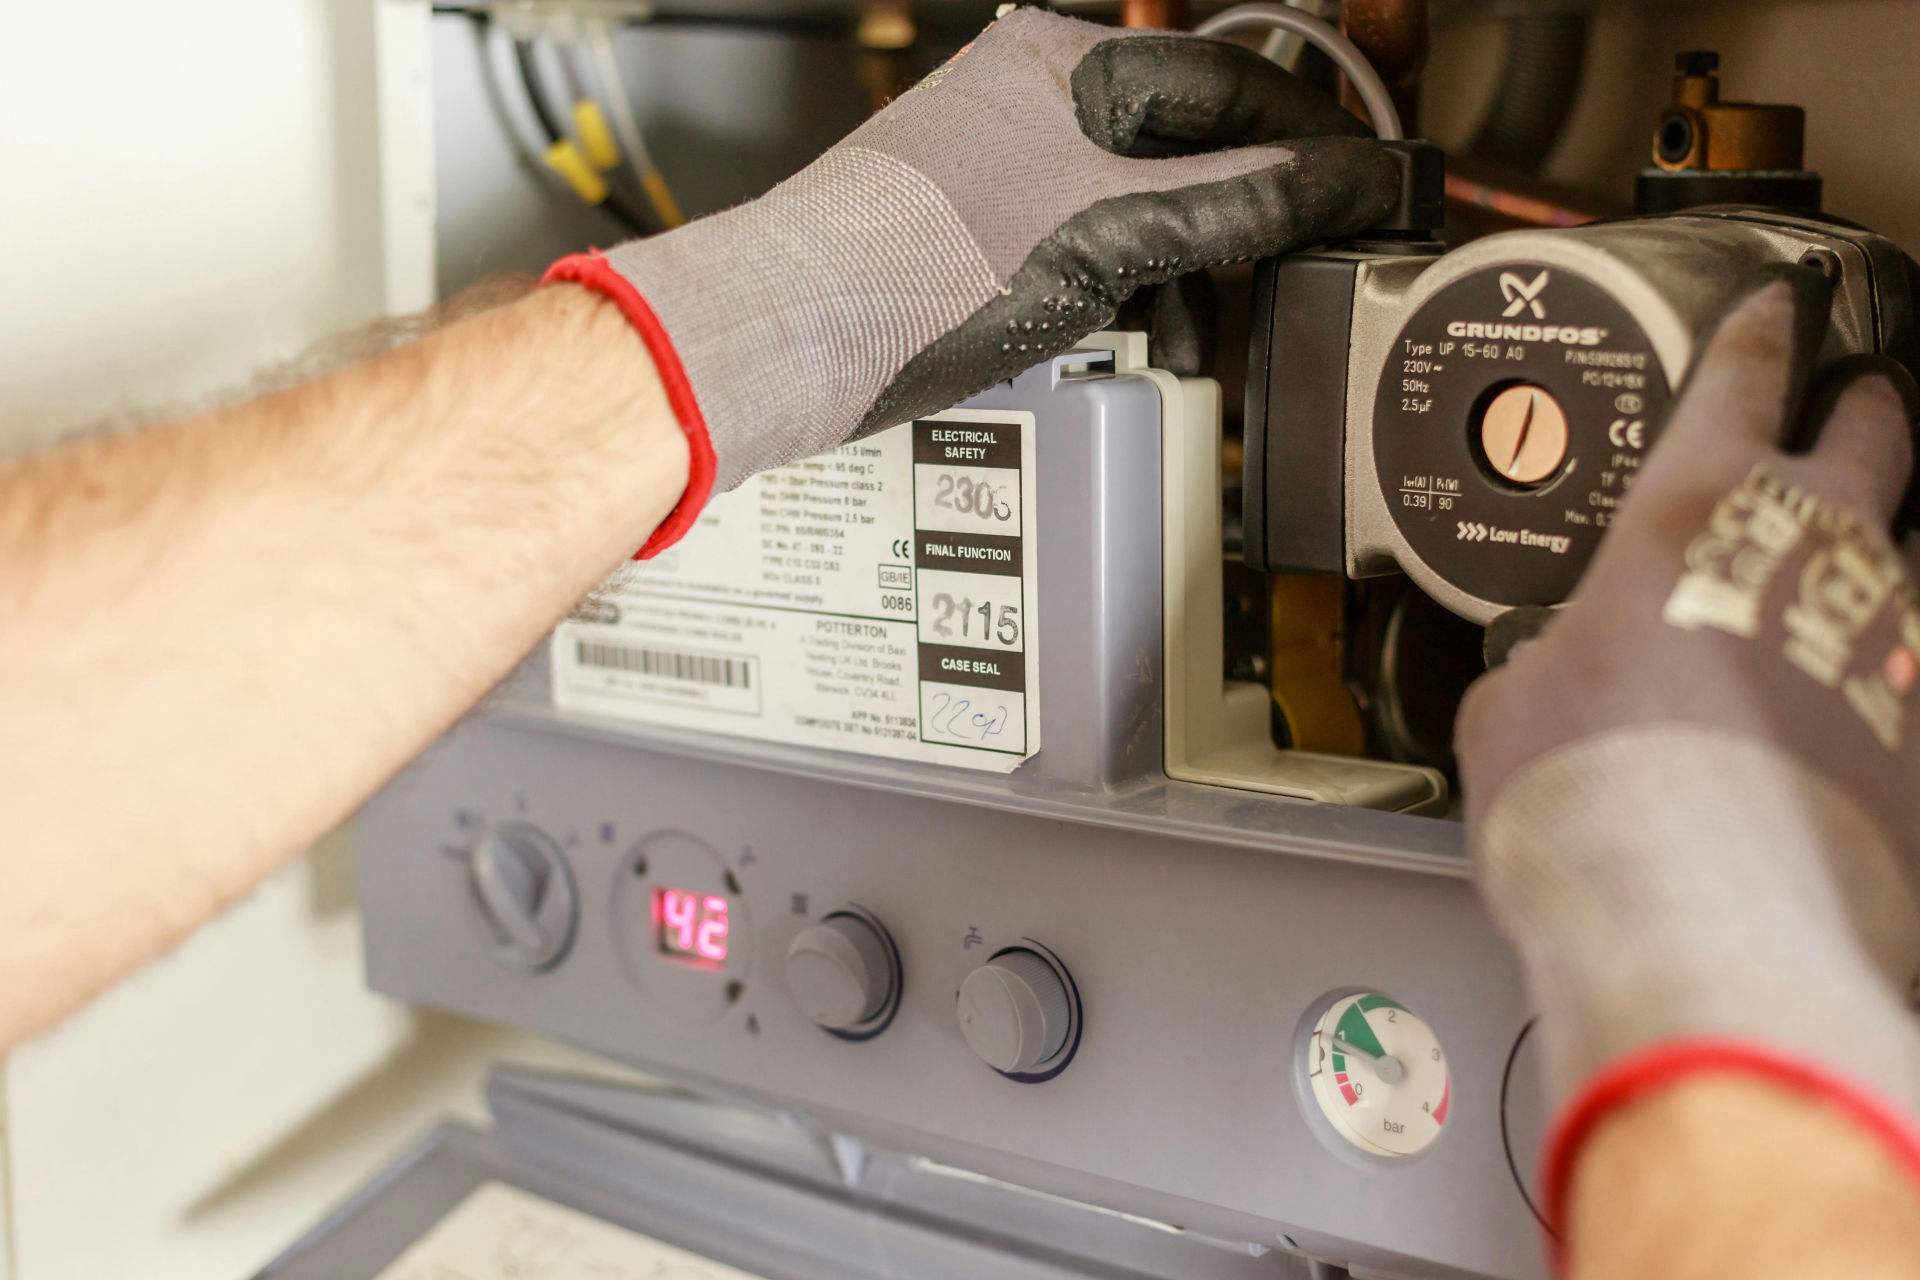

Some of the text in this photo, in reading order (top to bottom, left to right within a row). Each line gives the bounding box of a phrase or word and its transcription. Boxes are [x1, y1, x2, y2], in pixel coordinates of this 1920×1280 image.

[1447, 321, 1601, 346] GRUNDFOS
[1404, 340, 1432, 356] Type
[1439, 342, 1454, 356] UP
[1462, 344, 1499, 359] 15-60
[1402, 379, 1429, 393] 50Hz
[932, 430, 997, 444] ELECTRICAL
[945, 447, 986, 459] SAFETY
[849, 463, 865, 475] deg
[867, 464, 874, 474] C
[851, 480, 875, 491] class
[1403, 494, 1452, 510] 0.39 90
[860, 514, 875, 524] bar
[1490, 526, 1571, 554] Low Energy
[925, 543, 1011, 561] FINAL FUNCTION
[881, 595, 912, 611] 0086
[932, 592, 1019, 646] 2115
[816, 620, 887, 639] POTTERTON
[941, 658, 1000, 675] CASE SEAL
[663, 890, 729, 960] 42
[1388, 1010, 1396, 1023] 2
[1432, 1048, 1440, 1061] 3
[1422, 1101, 1430, 1113] 4
[1384, 1118, 1405, 1134] bar
